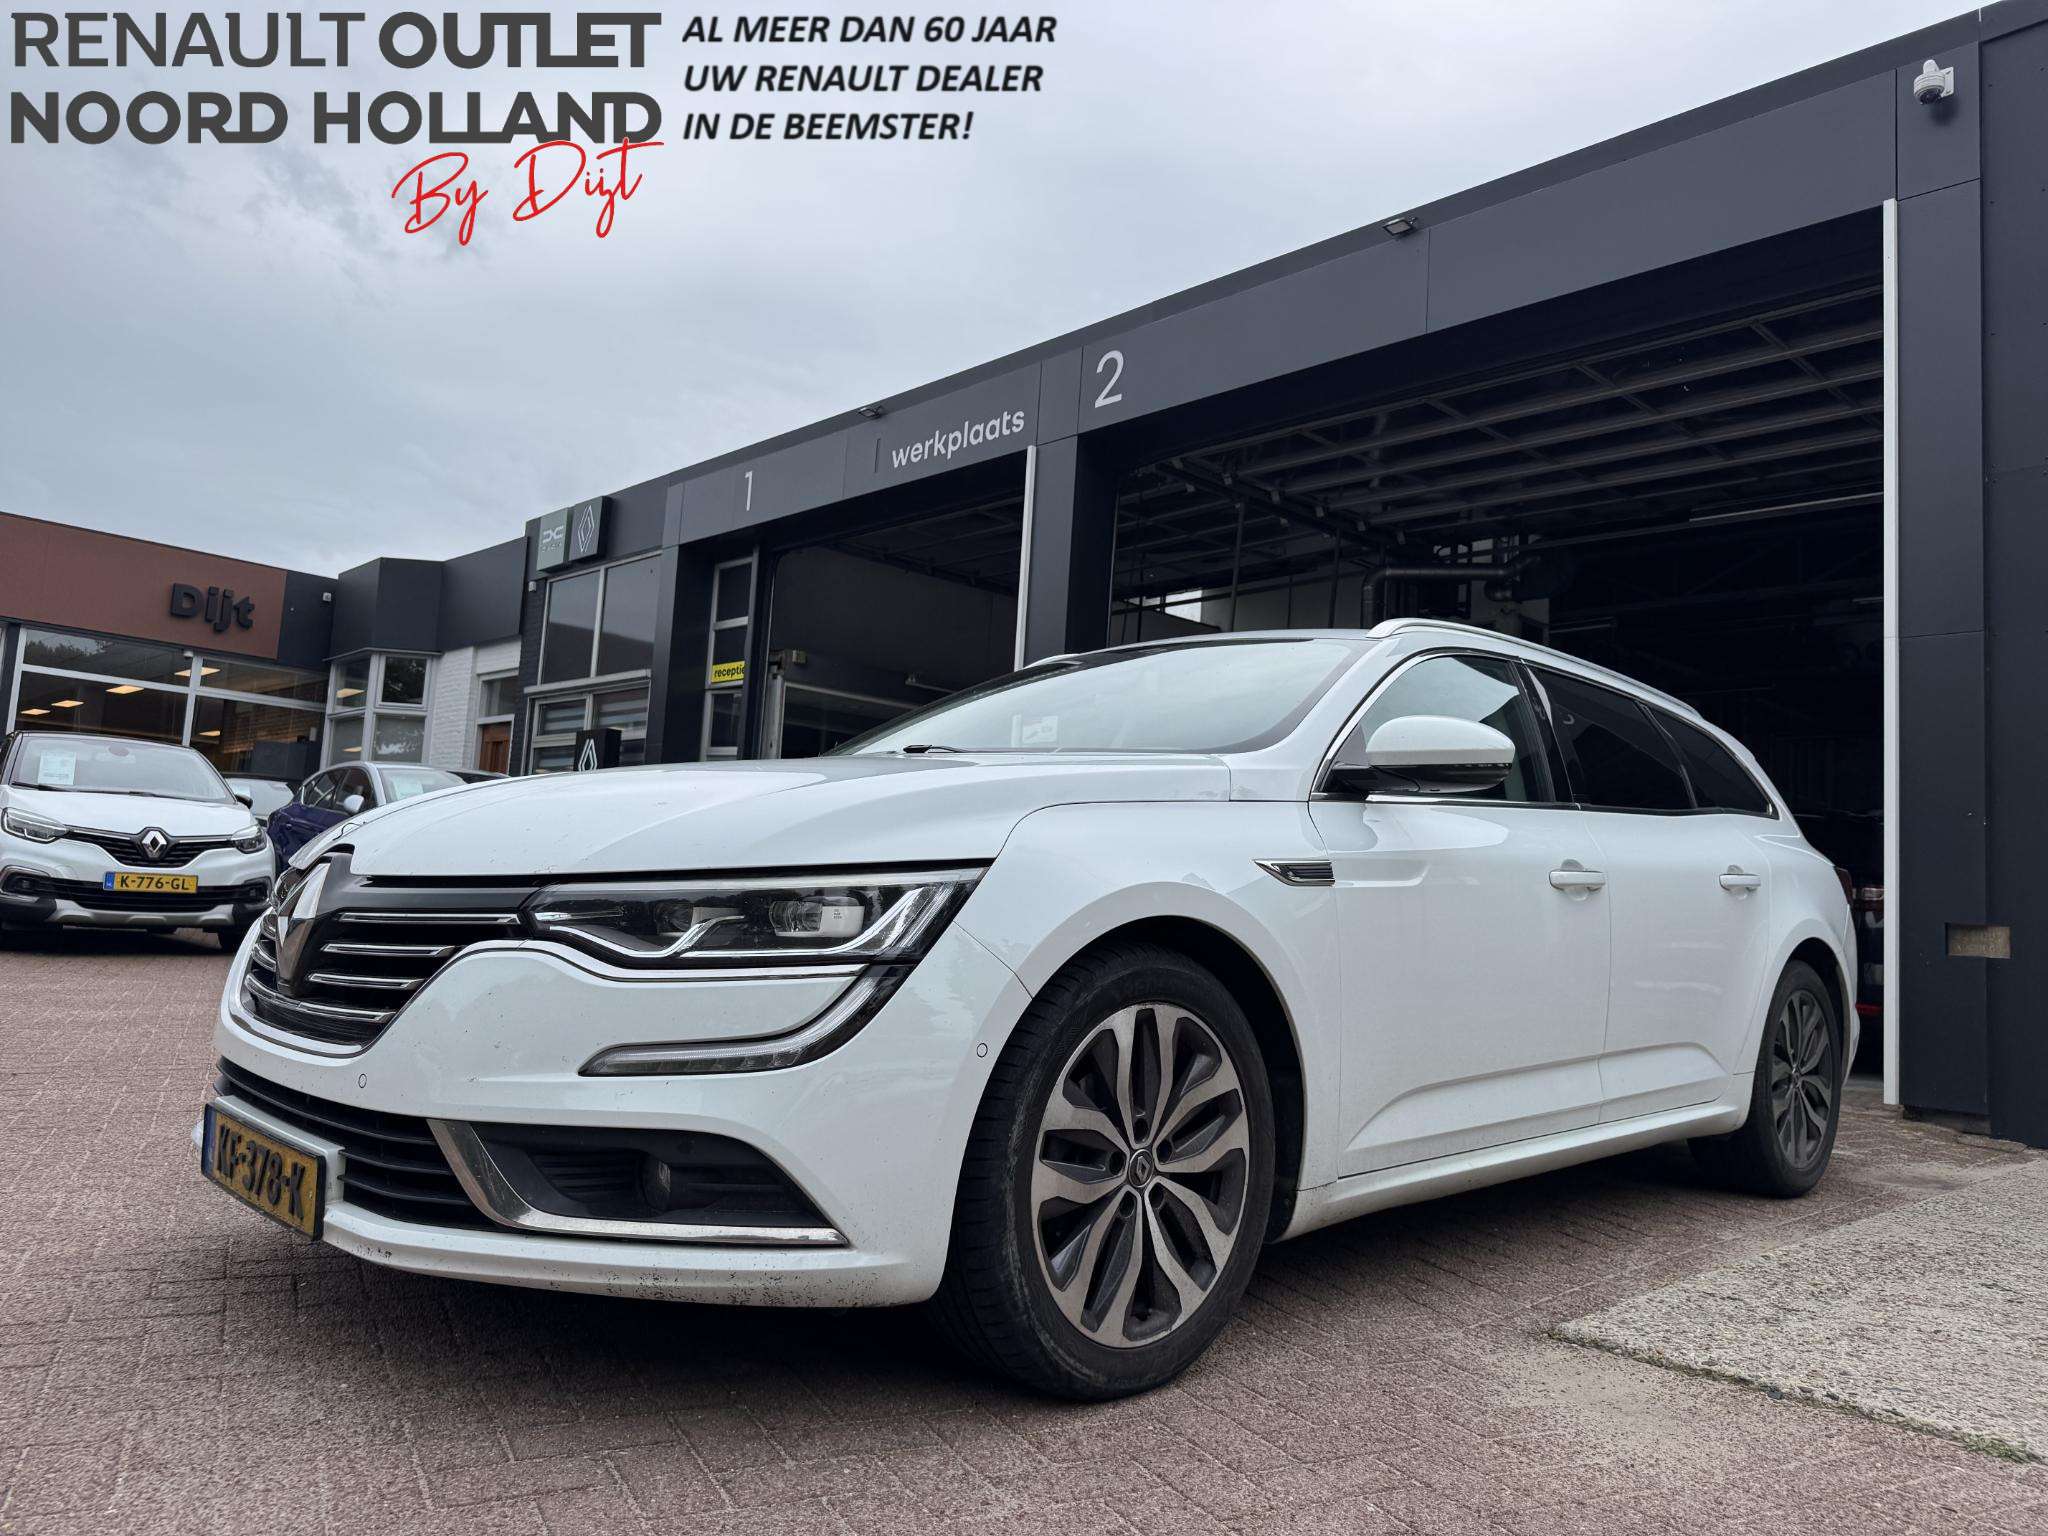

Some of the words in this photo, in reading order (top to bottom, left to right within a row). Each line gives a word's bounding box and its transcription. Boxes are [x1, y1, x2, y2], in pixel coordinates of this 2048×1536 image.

[1094, 350, 1124, 408] 2
[892, 408, 1025, 468] werkplaats
[744, 471, 753, 511] 1
[170, 582, 255, 633] Dijt
[120, 875, 190, 890] K-776-GL
